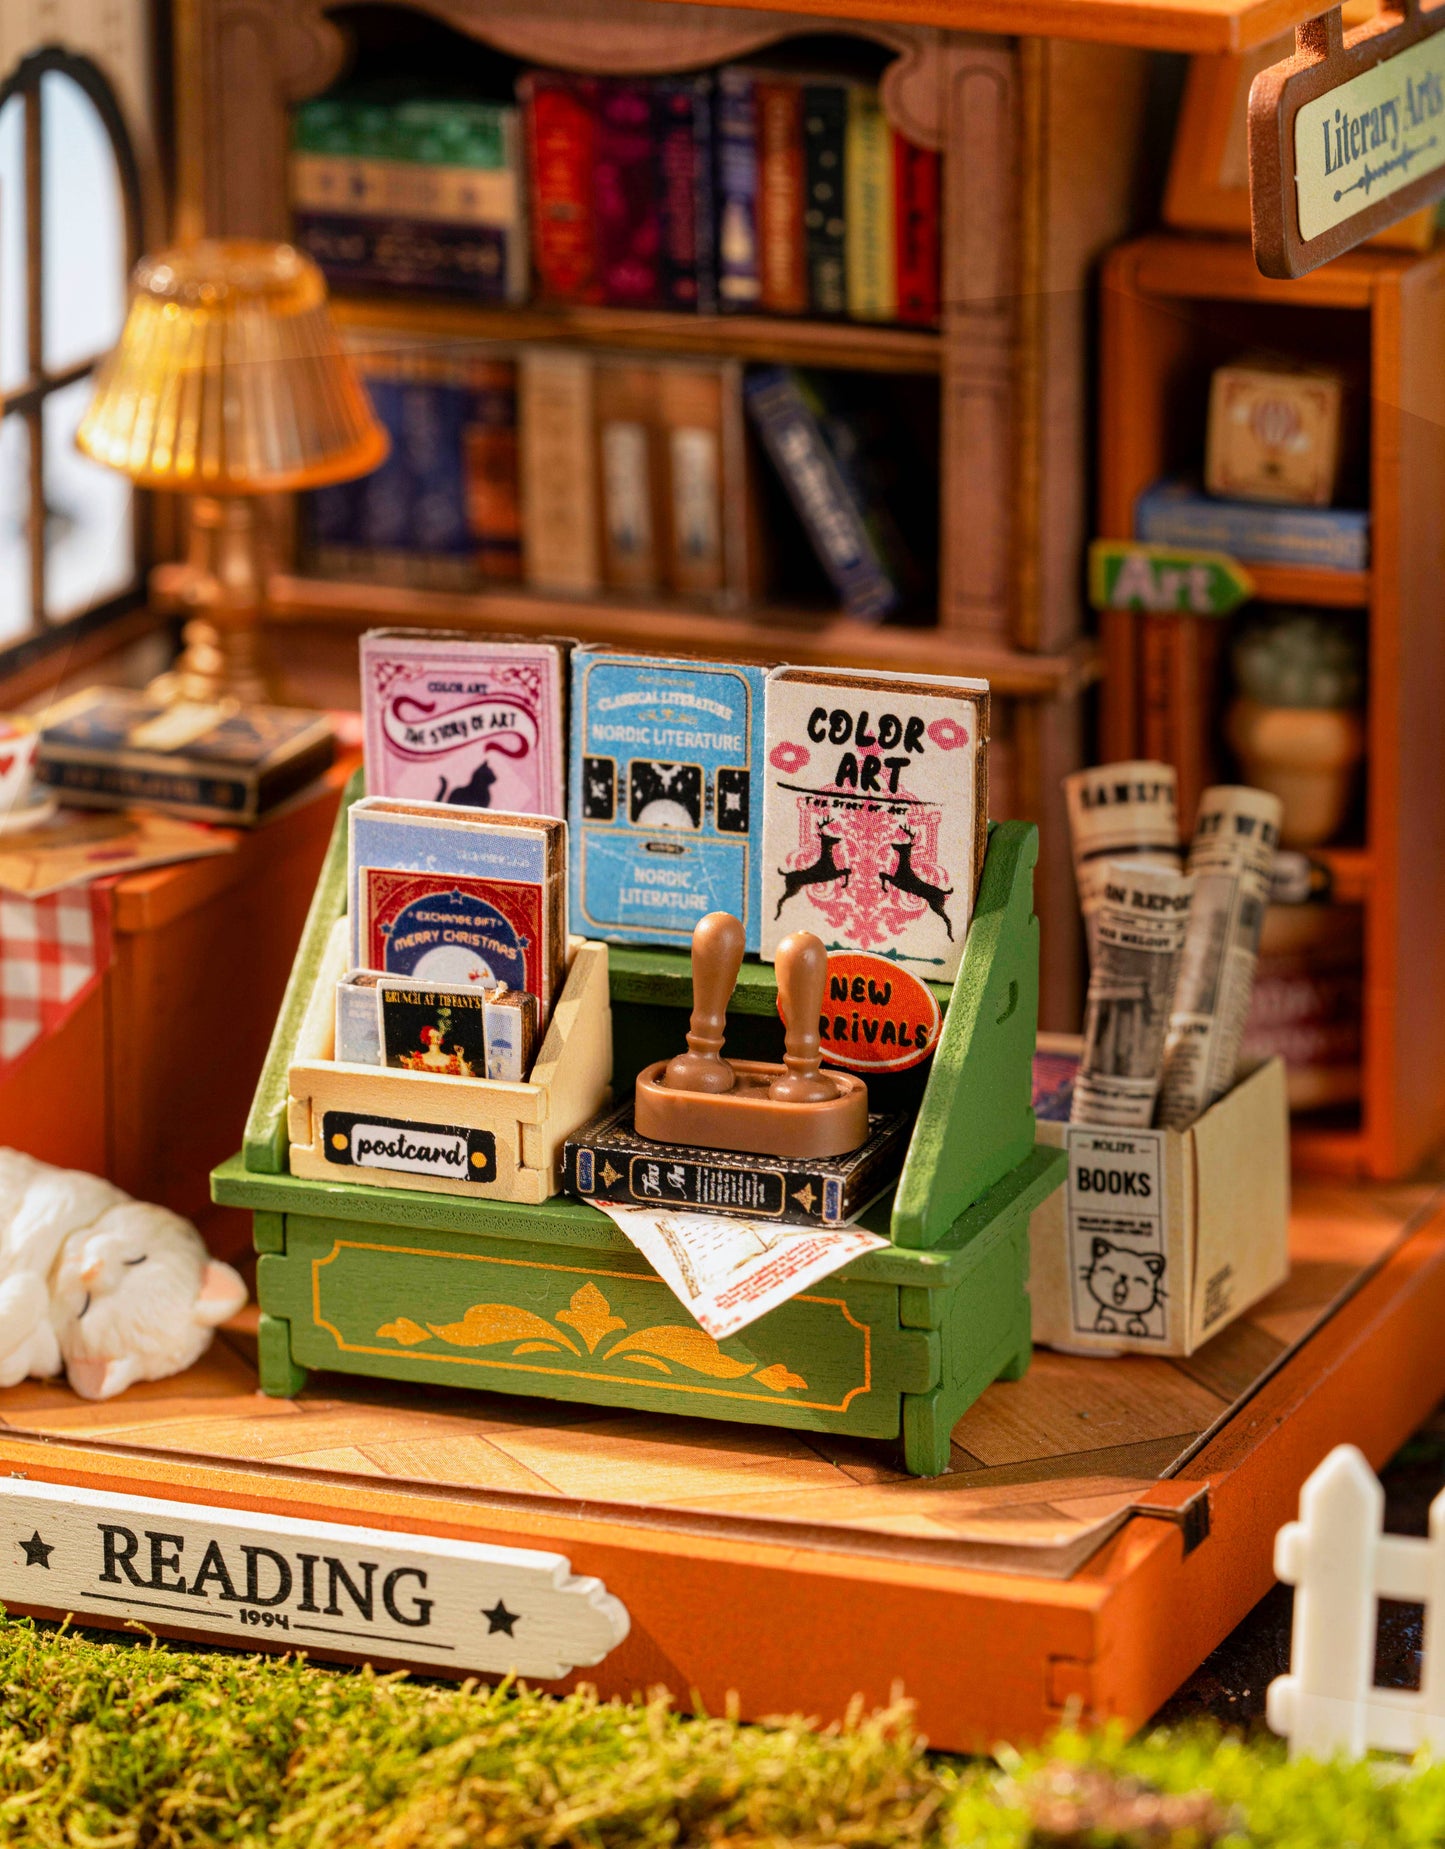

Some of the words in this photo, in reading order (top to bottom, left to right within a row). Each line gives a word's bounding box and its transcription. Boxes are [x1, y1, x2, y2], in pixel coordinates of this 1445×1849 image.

[1322, 96, 1400, 176] Literary
[1112, 554, 1213, 613] Art
[427, 681, 464, 693] COLOR
[466, 683, 487, 695] ART
[489, 712, 517, 729] ART
[660, 691, 734, 722] LITERATURE
[591, 724, 651, 745] NORDIC
[653, 728, 743, 752] LITERATURE
[807, 707, 925, 754] COLOR
[835, 752, 911, 794] ART
[634, 866, 692, 888] NORDIC
[620, 888, 708, 911] LITERATURE
[415, 910, 472, 927] EXCHANGE
[473, 914, 496, 928] GIFT
[394, 930, 440, 952] MERRY
[443, 929, 518, 960] CHRISTMAS
[830, 976, 892, 1007] NEW
[356, 1133, 467, 1167] postcard
[1077, 1167, 1151, 1198] BOOKS
[97, 1523, 434, 1627] READING
[239, 1608, 290, 1630] 1994
